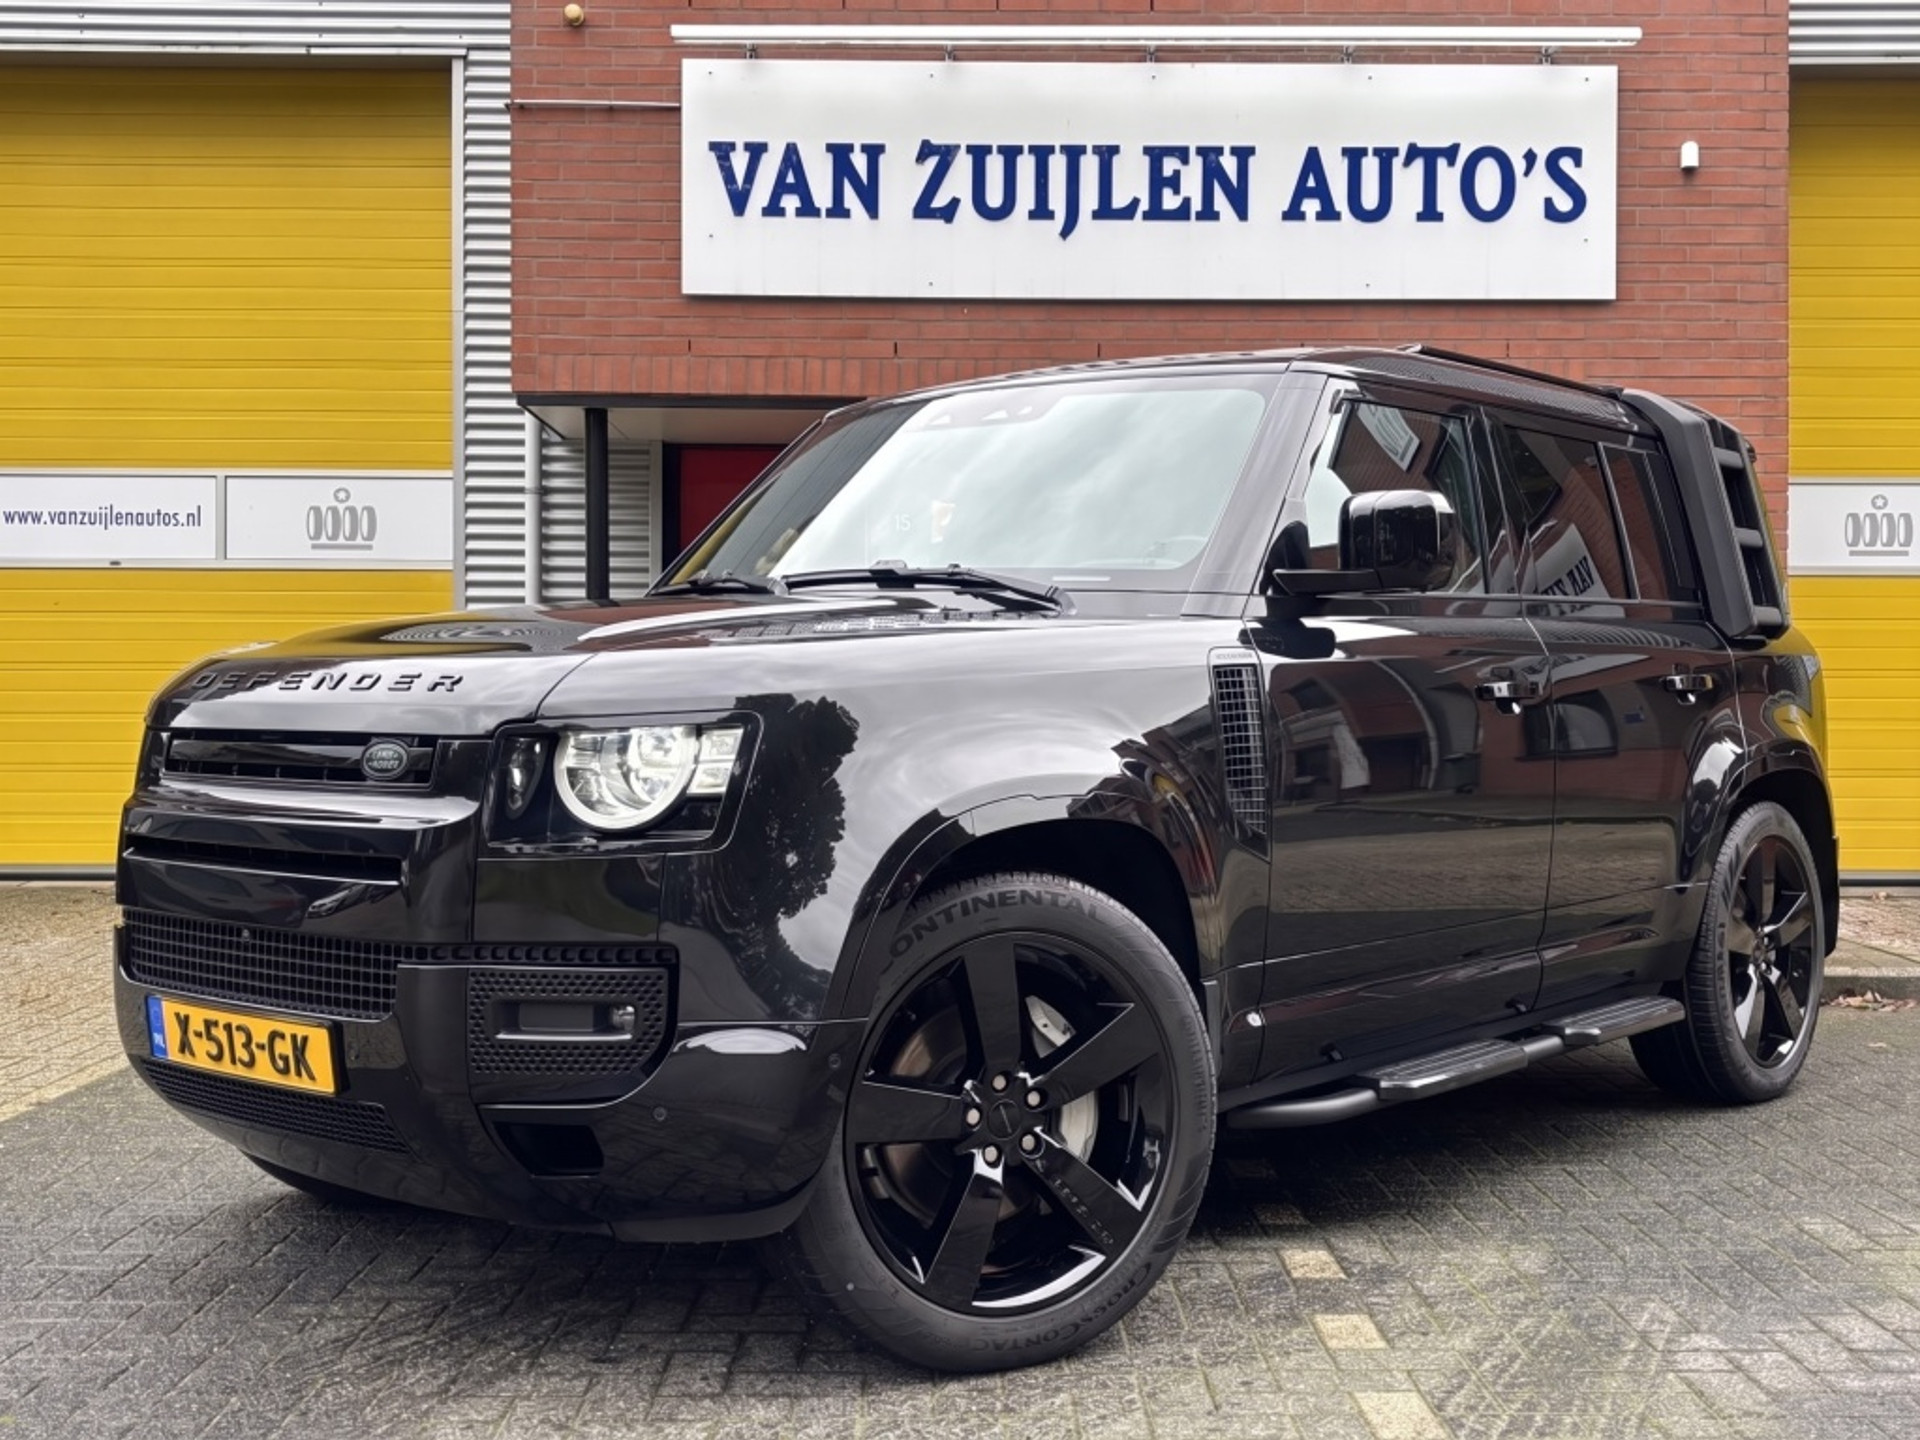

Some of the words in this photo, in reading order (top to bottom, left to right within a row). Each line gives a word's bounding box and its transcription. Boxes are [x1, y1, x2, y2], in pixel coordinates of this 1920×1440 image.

[708, 141, 886, 220] VAN
[912, 139, 1256, 240] ZUIJLEN
[1281, 142, 1587, 224] AUTO'S
[2, 503, 202, 531] www.vanzuijlenautos.nl
[190, 672, 464, 692] DEFENDER
[880, 888, 1105, 975] ONTINENTAL
[174, 1012, 317, 1082] X-513-GK
